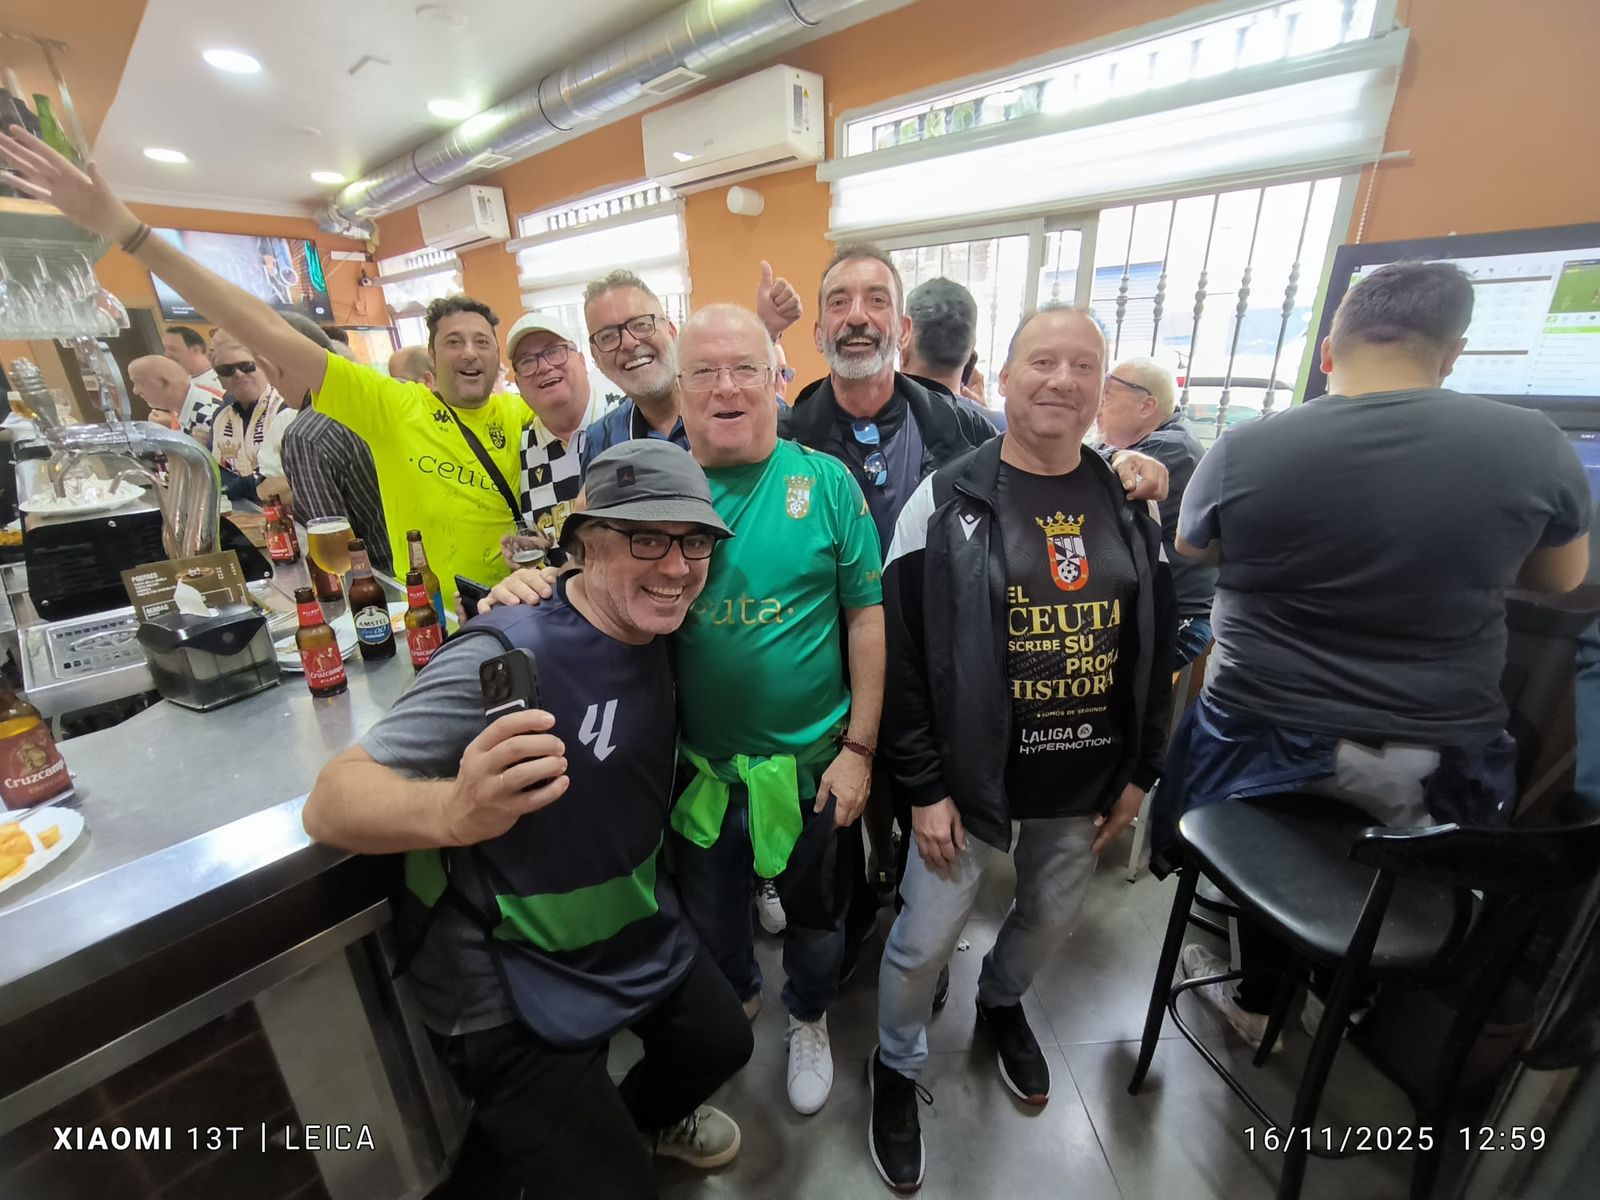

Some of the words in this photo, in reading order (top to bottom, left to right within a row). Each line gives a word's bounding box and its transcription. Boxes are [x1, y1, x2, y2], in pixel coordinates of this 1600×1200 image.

[1007, 585, 1030, 604] EL
[358, 618, 387, 627] AMSTEL
[1009, 599, 1120, 636] CEUTA
[1008, 639, 1061, 652] SCRIBE
[1063, 634, 1094, 654] SU
[1021, 727, 1074, 744] LALIGA
[1019, 736, 1112, 755] HYPERMOTION
